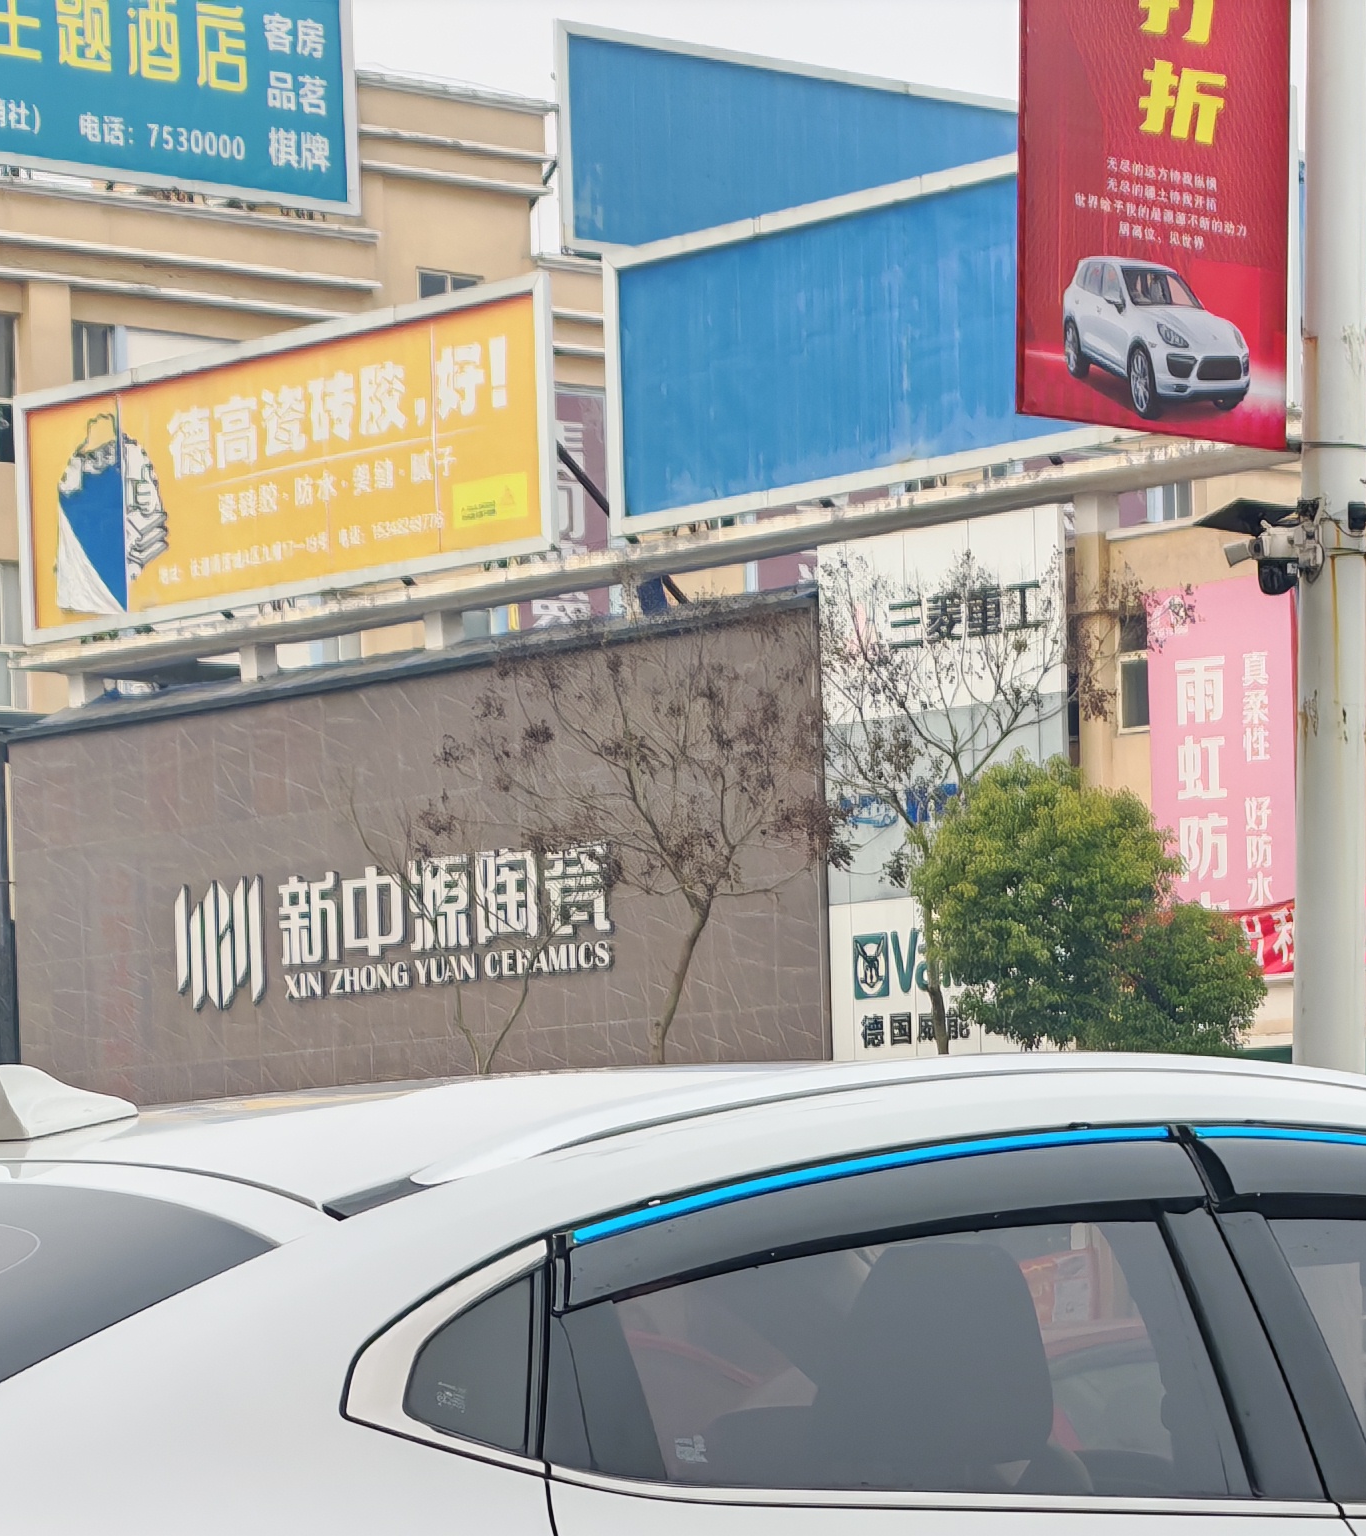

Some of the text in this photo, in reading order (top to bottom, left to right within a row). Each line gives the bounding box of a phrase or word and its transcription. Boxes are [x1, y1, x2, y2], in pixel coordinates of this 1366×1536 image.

[262, 13, 325, 59] 客房
[267, 70, 328, 116] 品茗
[267, 128, 331, 172] 棋牌
[888, 579, 1047, 650] 三菱重工
[1241, 651, 1274, 906] 真柔性 好防水
[277, 838, 614, 967] 新中源陶瓷
[283, 939, 612, 1000] XIN ZHONG YUAN CERAMICS
